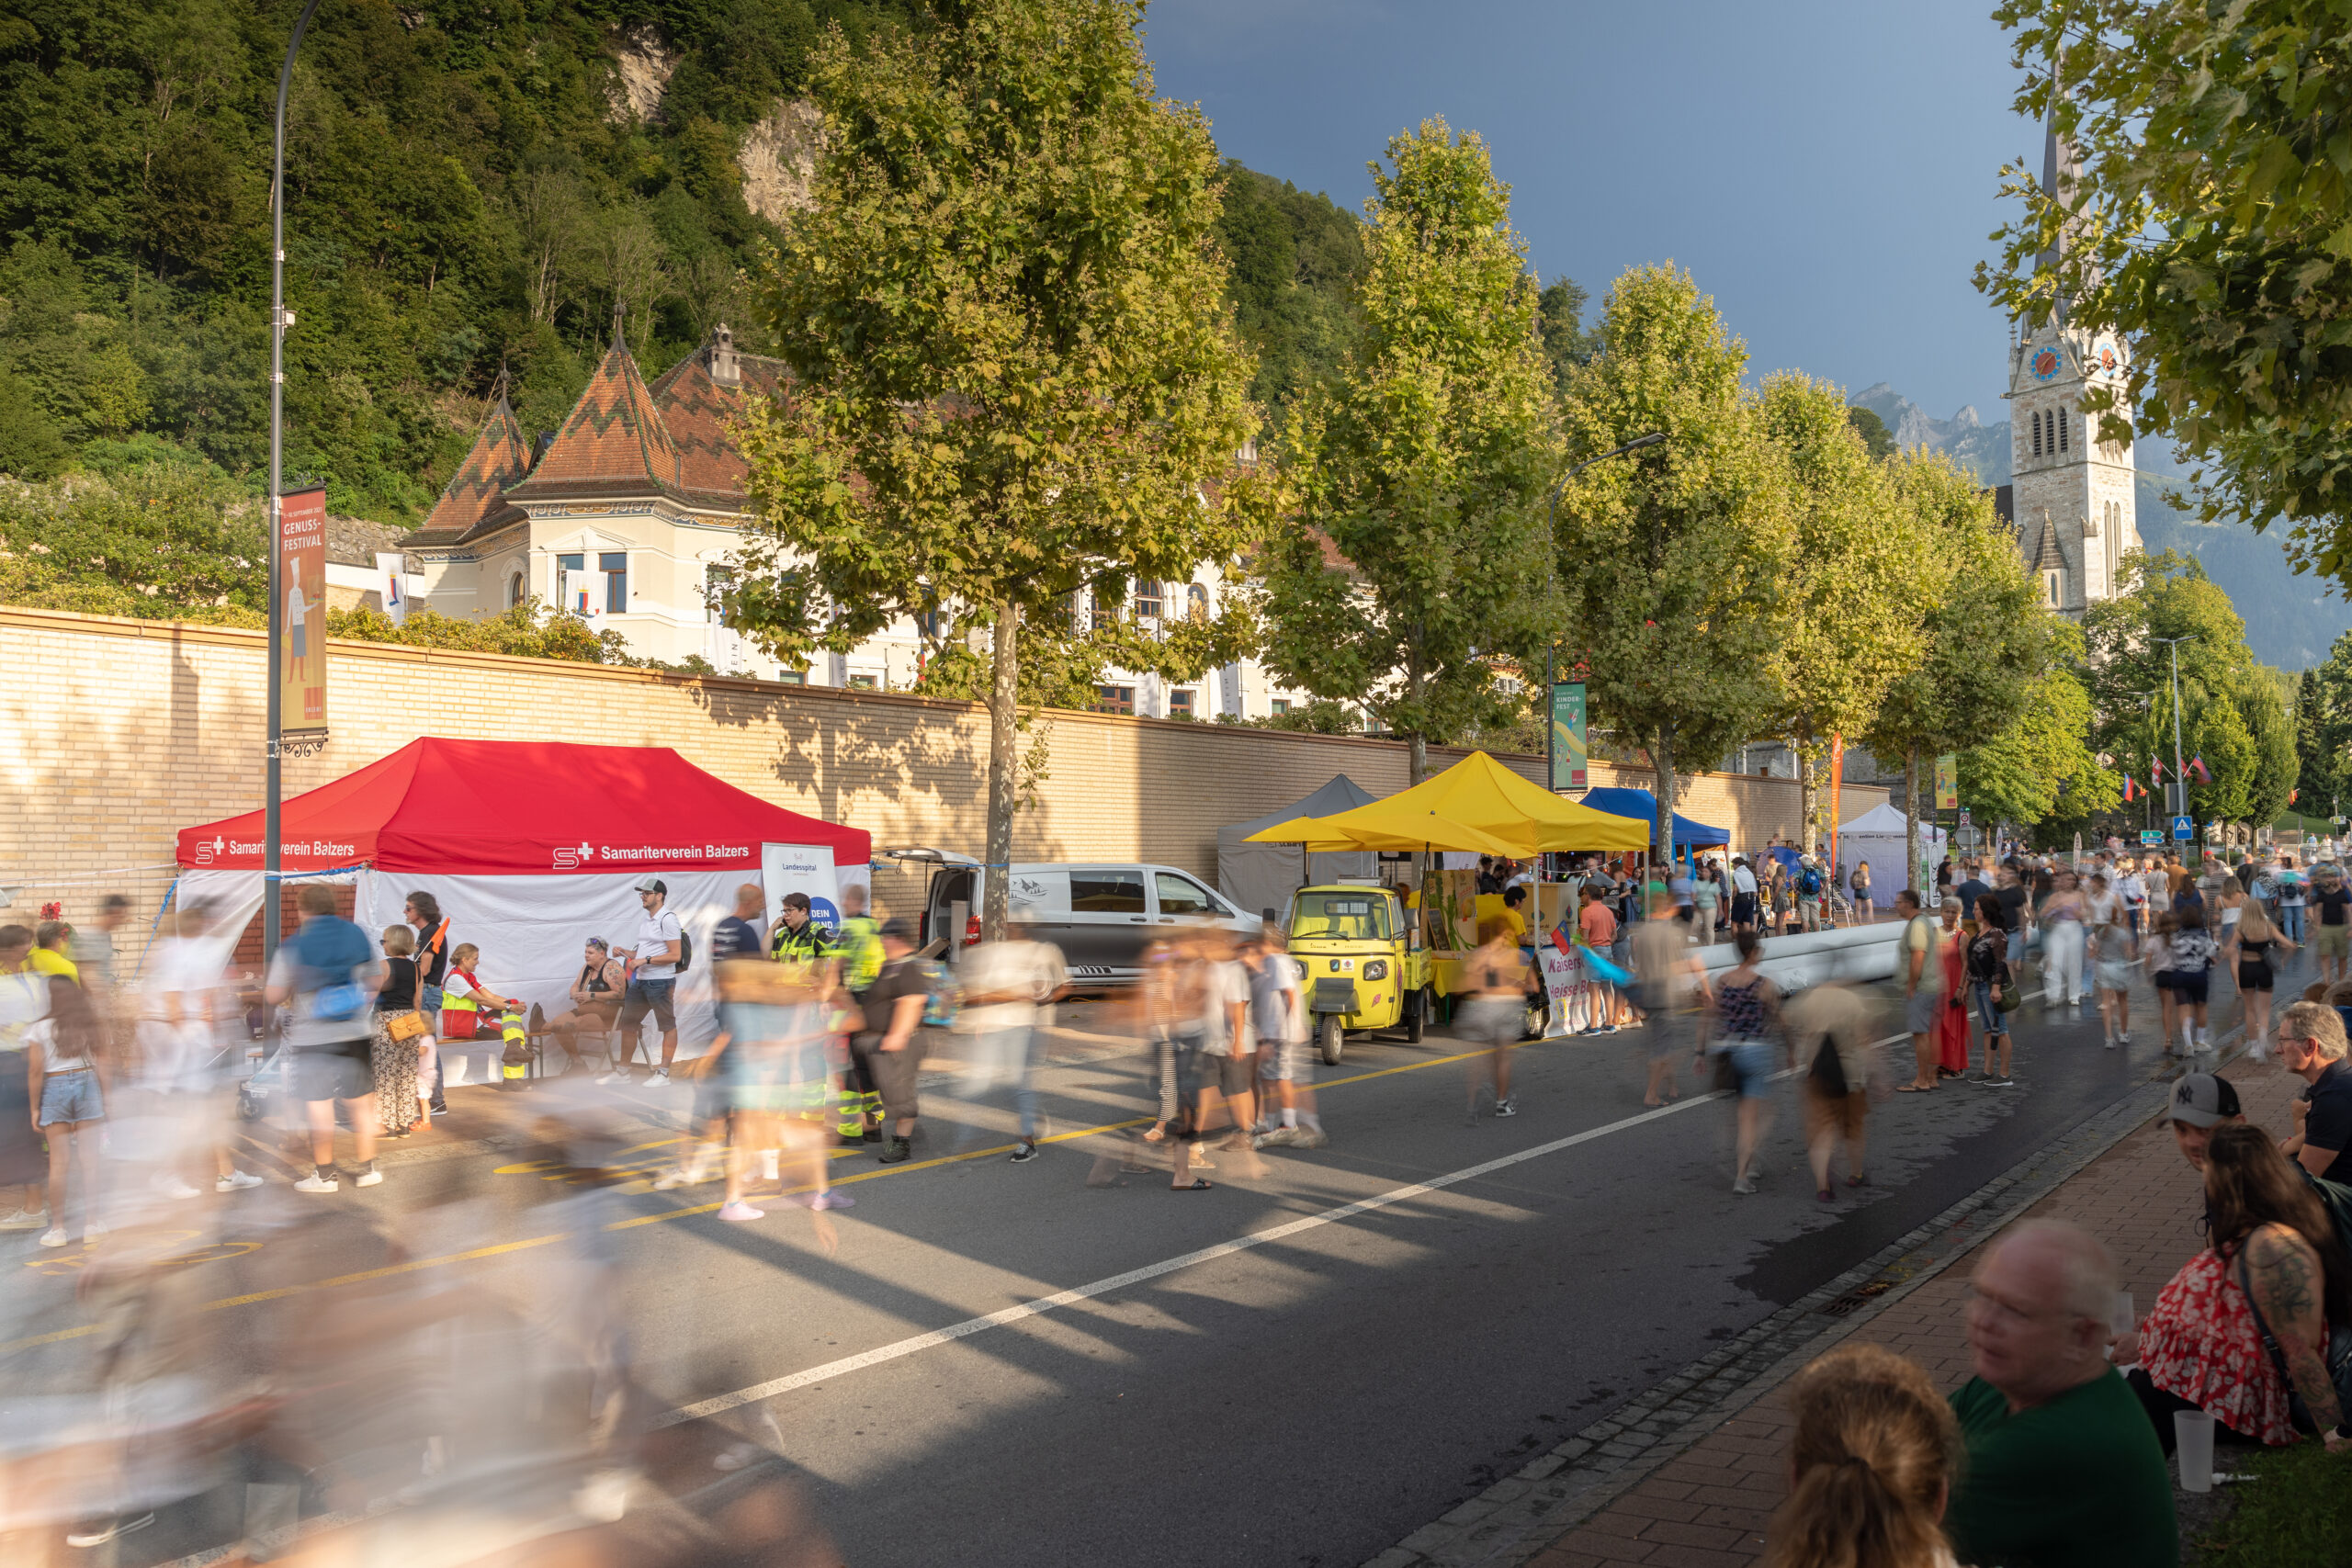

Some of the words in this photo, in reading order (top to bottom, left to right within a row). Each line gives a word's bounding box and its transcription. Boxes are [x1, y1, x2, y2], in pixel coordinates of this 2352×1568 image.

[284, 519, 322, 535] GENUSS-
[284, 535, 322, 551] FESTIVAL
[230, 840, 310, 856] Samariverein
[313, 840, 355, 856] Balzers
[601, 845, 701, 860] Samariterverein
[706, 844, 749, 858] Balzers
[782, 863, 817, 873] Landesspital
[811, 909, 830, 918] DEIN
[1549, 982, 1578, 999] Heisse
[2177, 1085, 2194, 1104] NY
